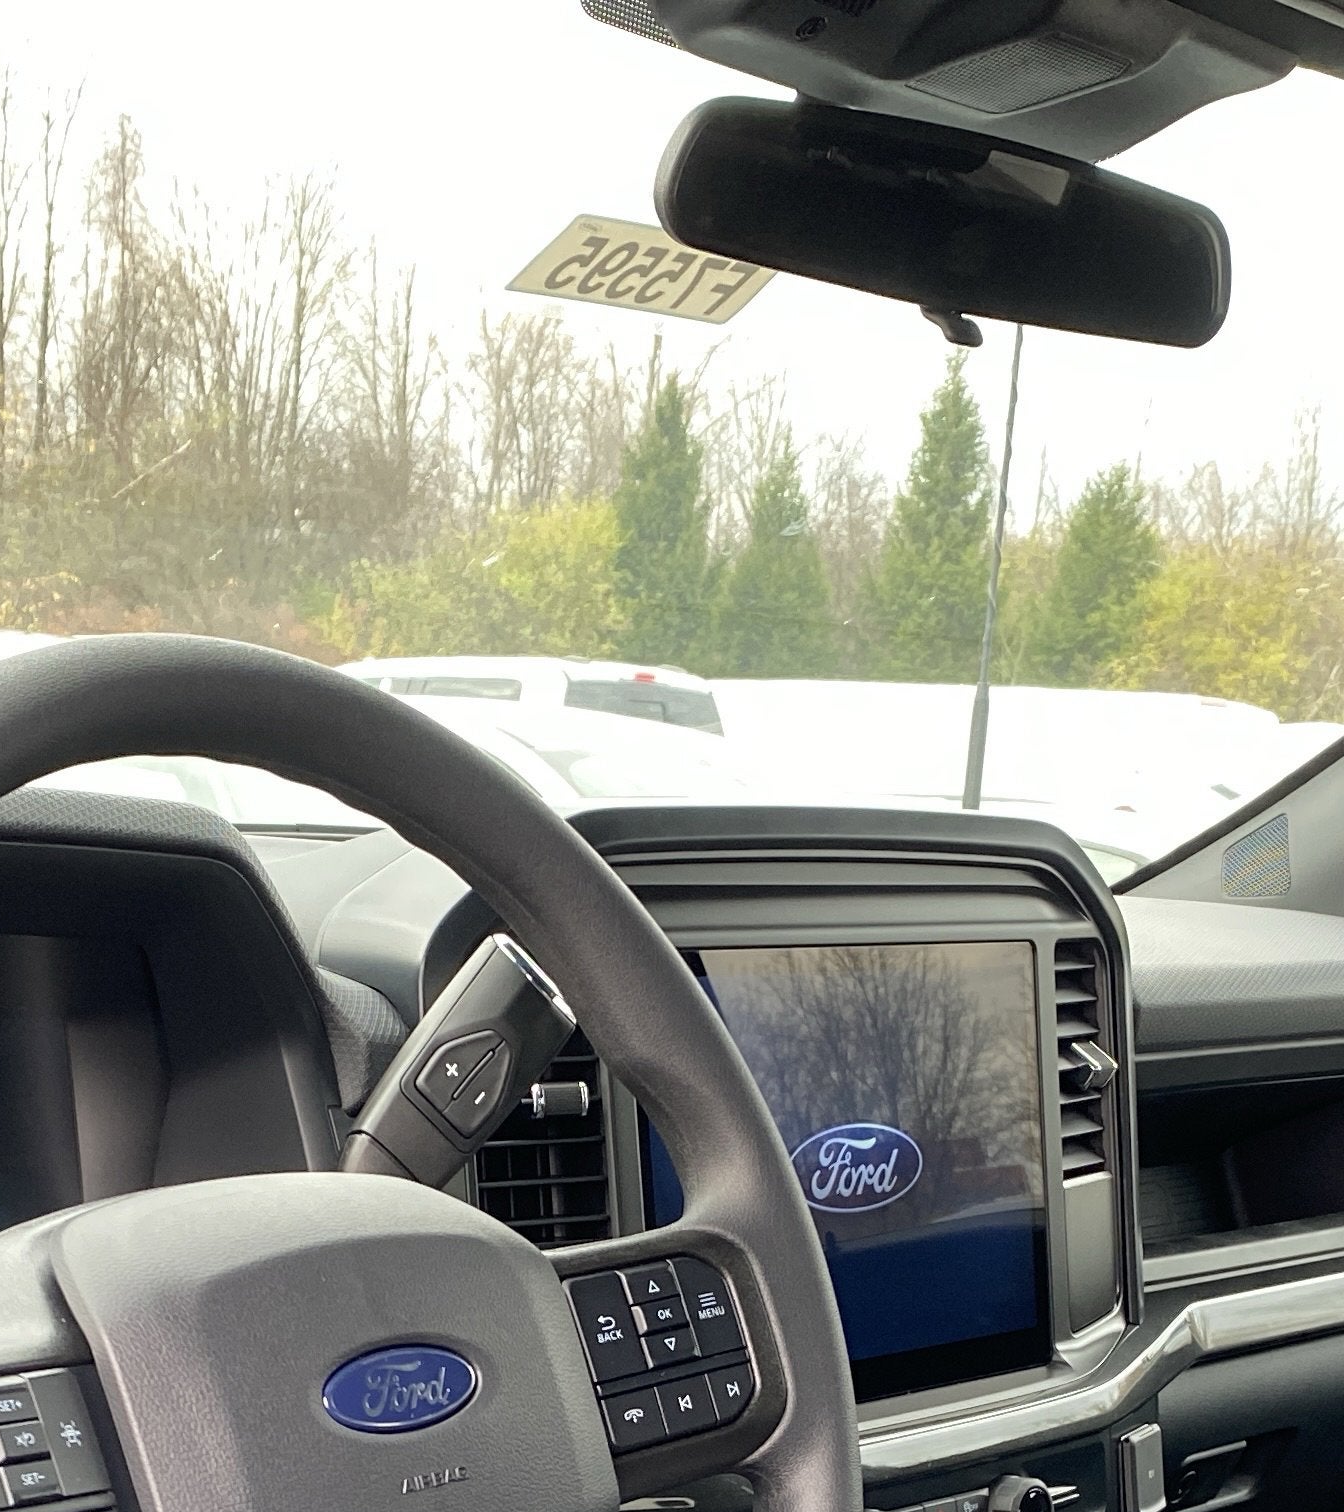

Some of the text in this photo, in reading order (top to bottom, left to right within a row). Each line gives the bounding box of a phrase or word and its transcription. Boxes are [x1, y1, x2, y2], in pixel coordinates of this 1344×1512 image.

[811, 1136, 899, 1200] Ford
[657, 1308, 673, 1320] OK
[697, 1306, 726, 1320] MENU
[597, 1329, 624, 1344] BACK
[363, 1360, 451, 1418] Ford
